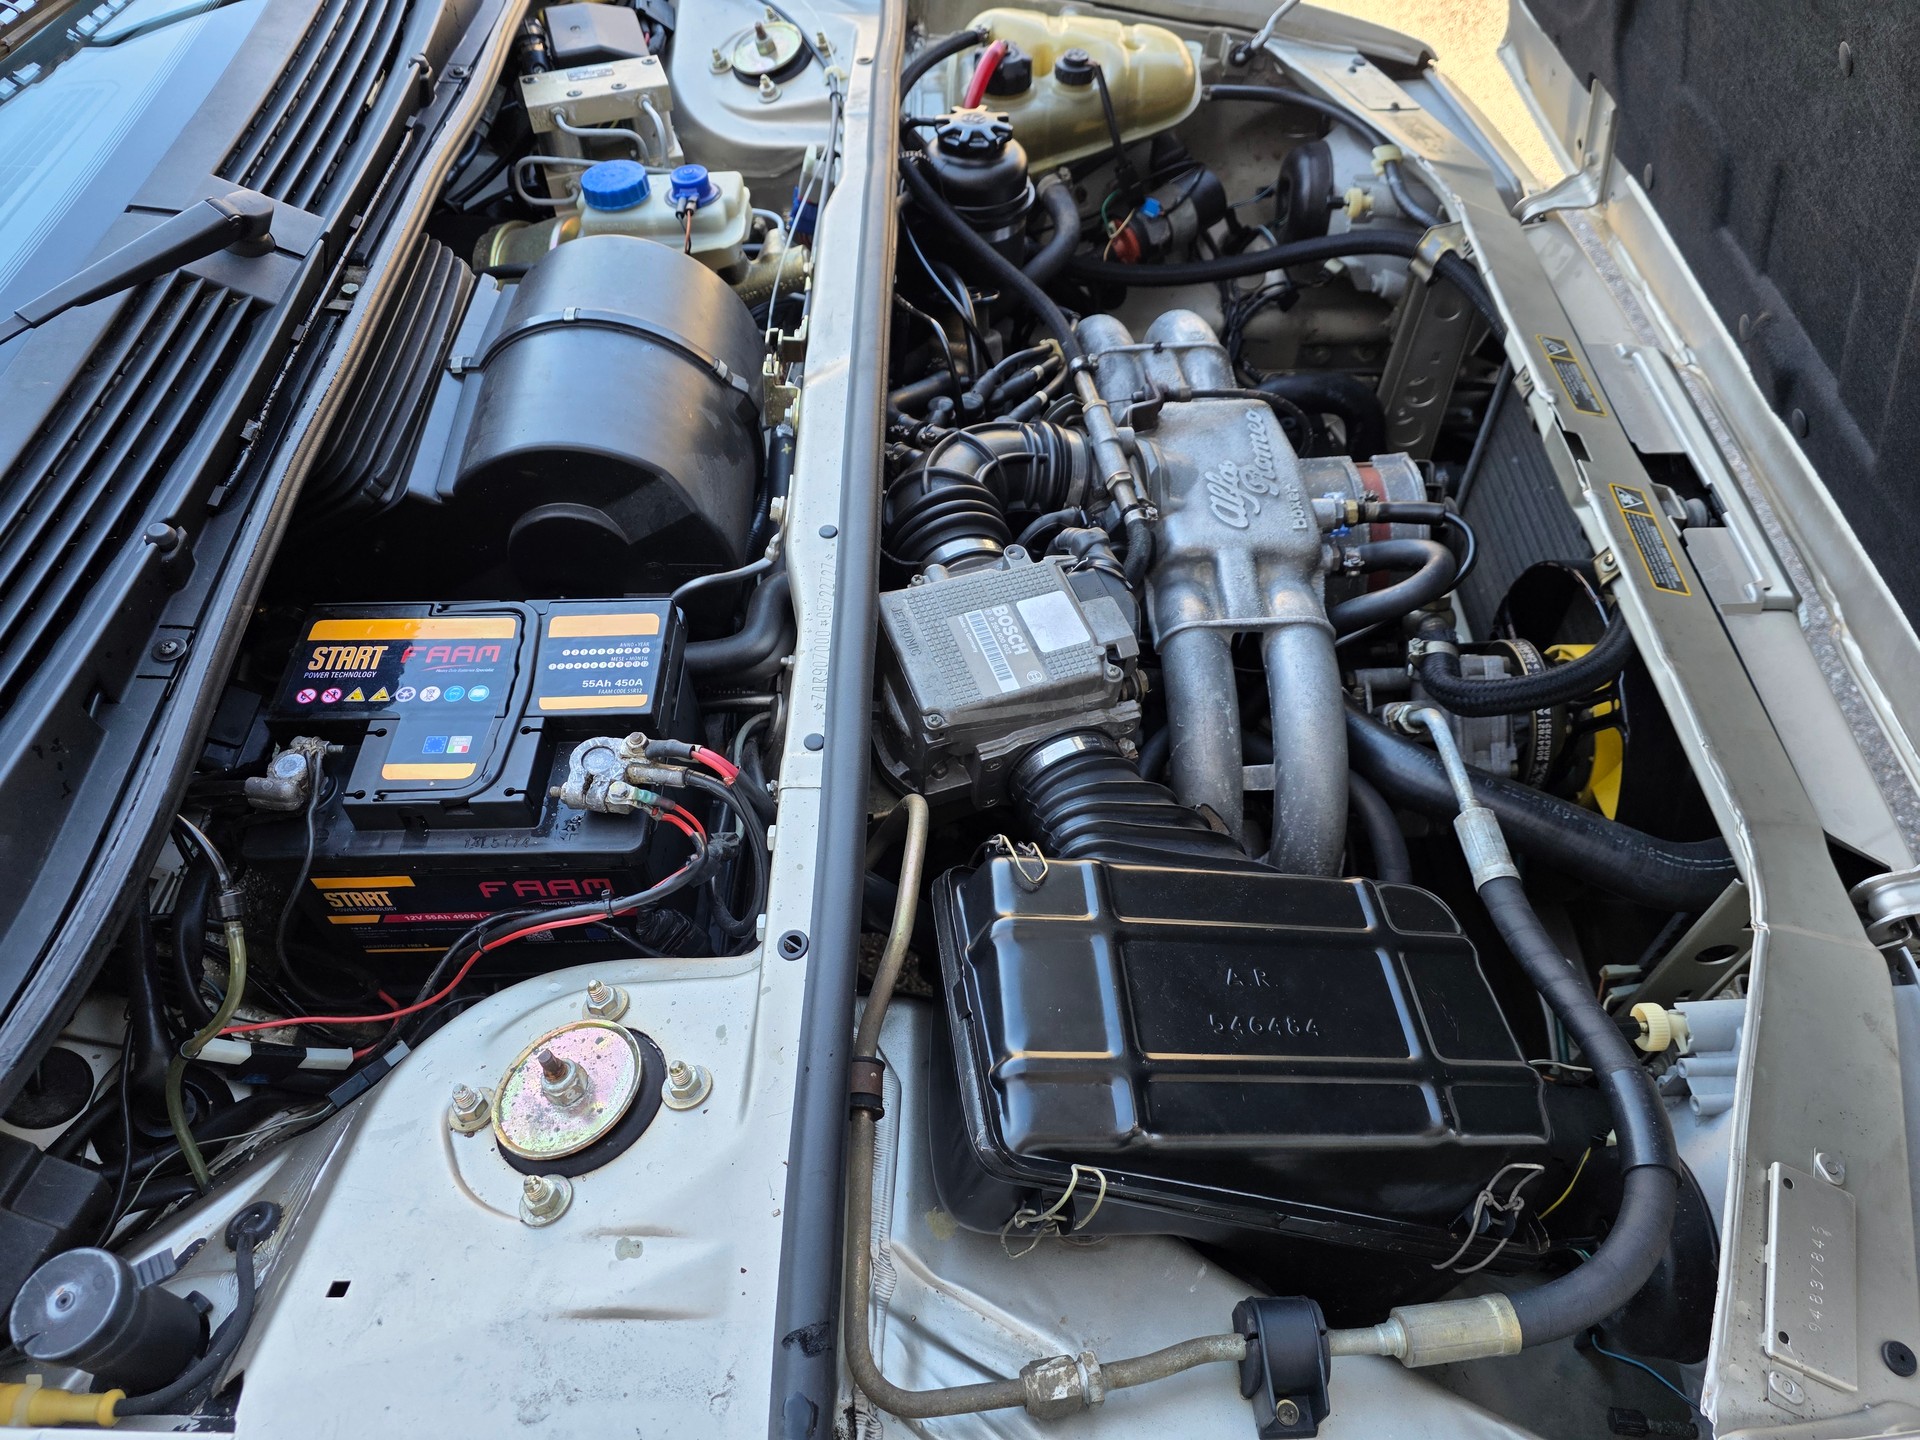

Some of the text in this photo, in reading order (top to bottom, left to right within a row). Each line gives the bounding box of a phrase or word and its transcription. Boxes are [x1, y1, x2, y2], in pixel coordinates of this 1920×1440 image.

[1239, 408, 1279, 496] Romeo
[1205, 460, 1260, 528] Alfa
[890, 607, 922, 657] JETRONIC
[992, 605, 1029, 655] BOSCH
[997, 631, 1006, 643] 000
[307, 645, 389, 671] START
[400, 645, 501, 663] FAAM
[303, 671, 330, 679] POWER
[582, 678, 643, 688] 55Ah 450A
[478, 878, 615, 898] FAAM
[323, 890, 394, 908] START
